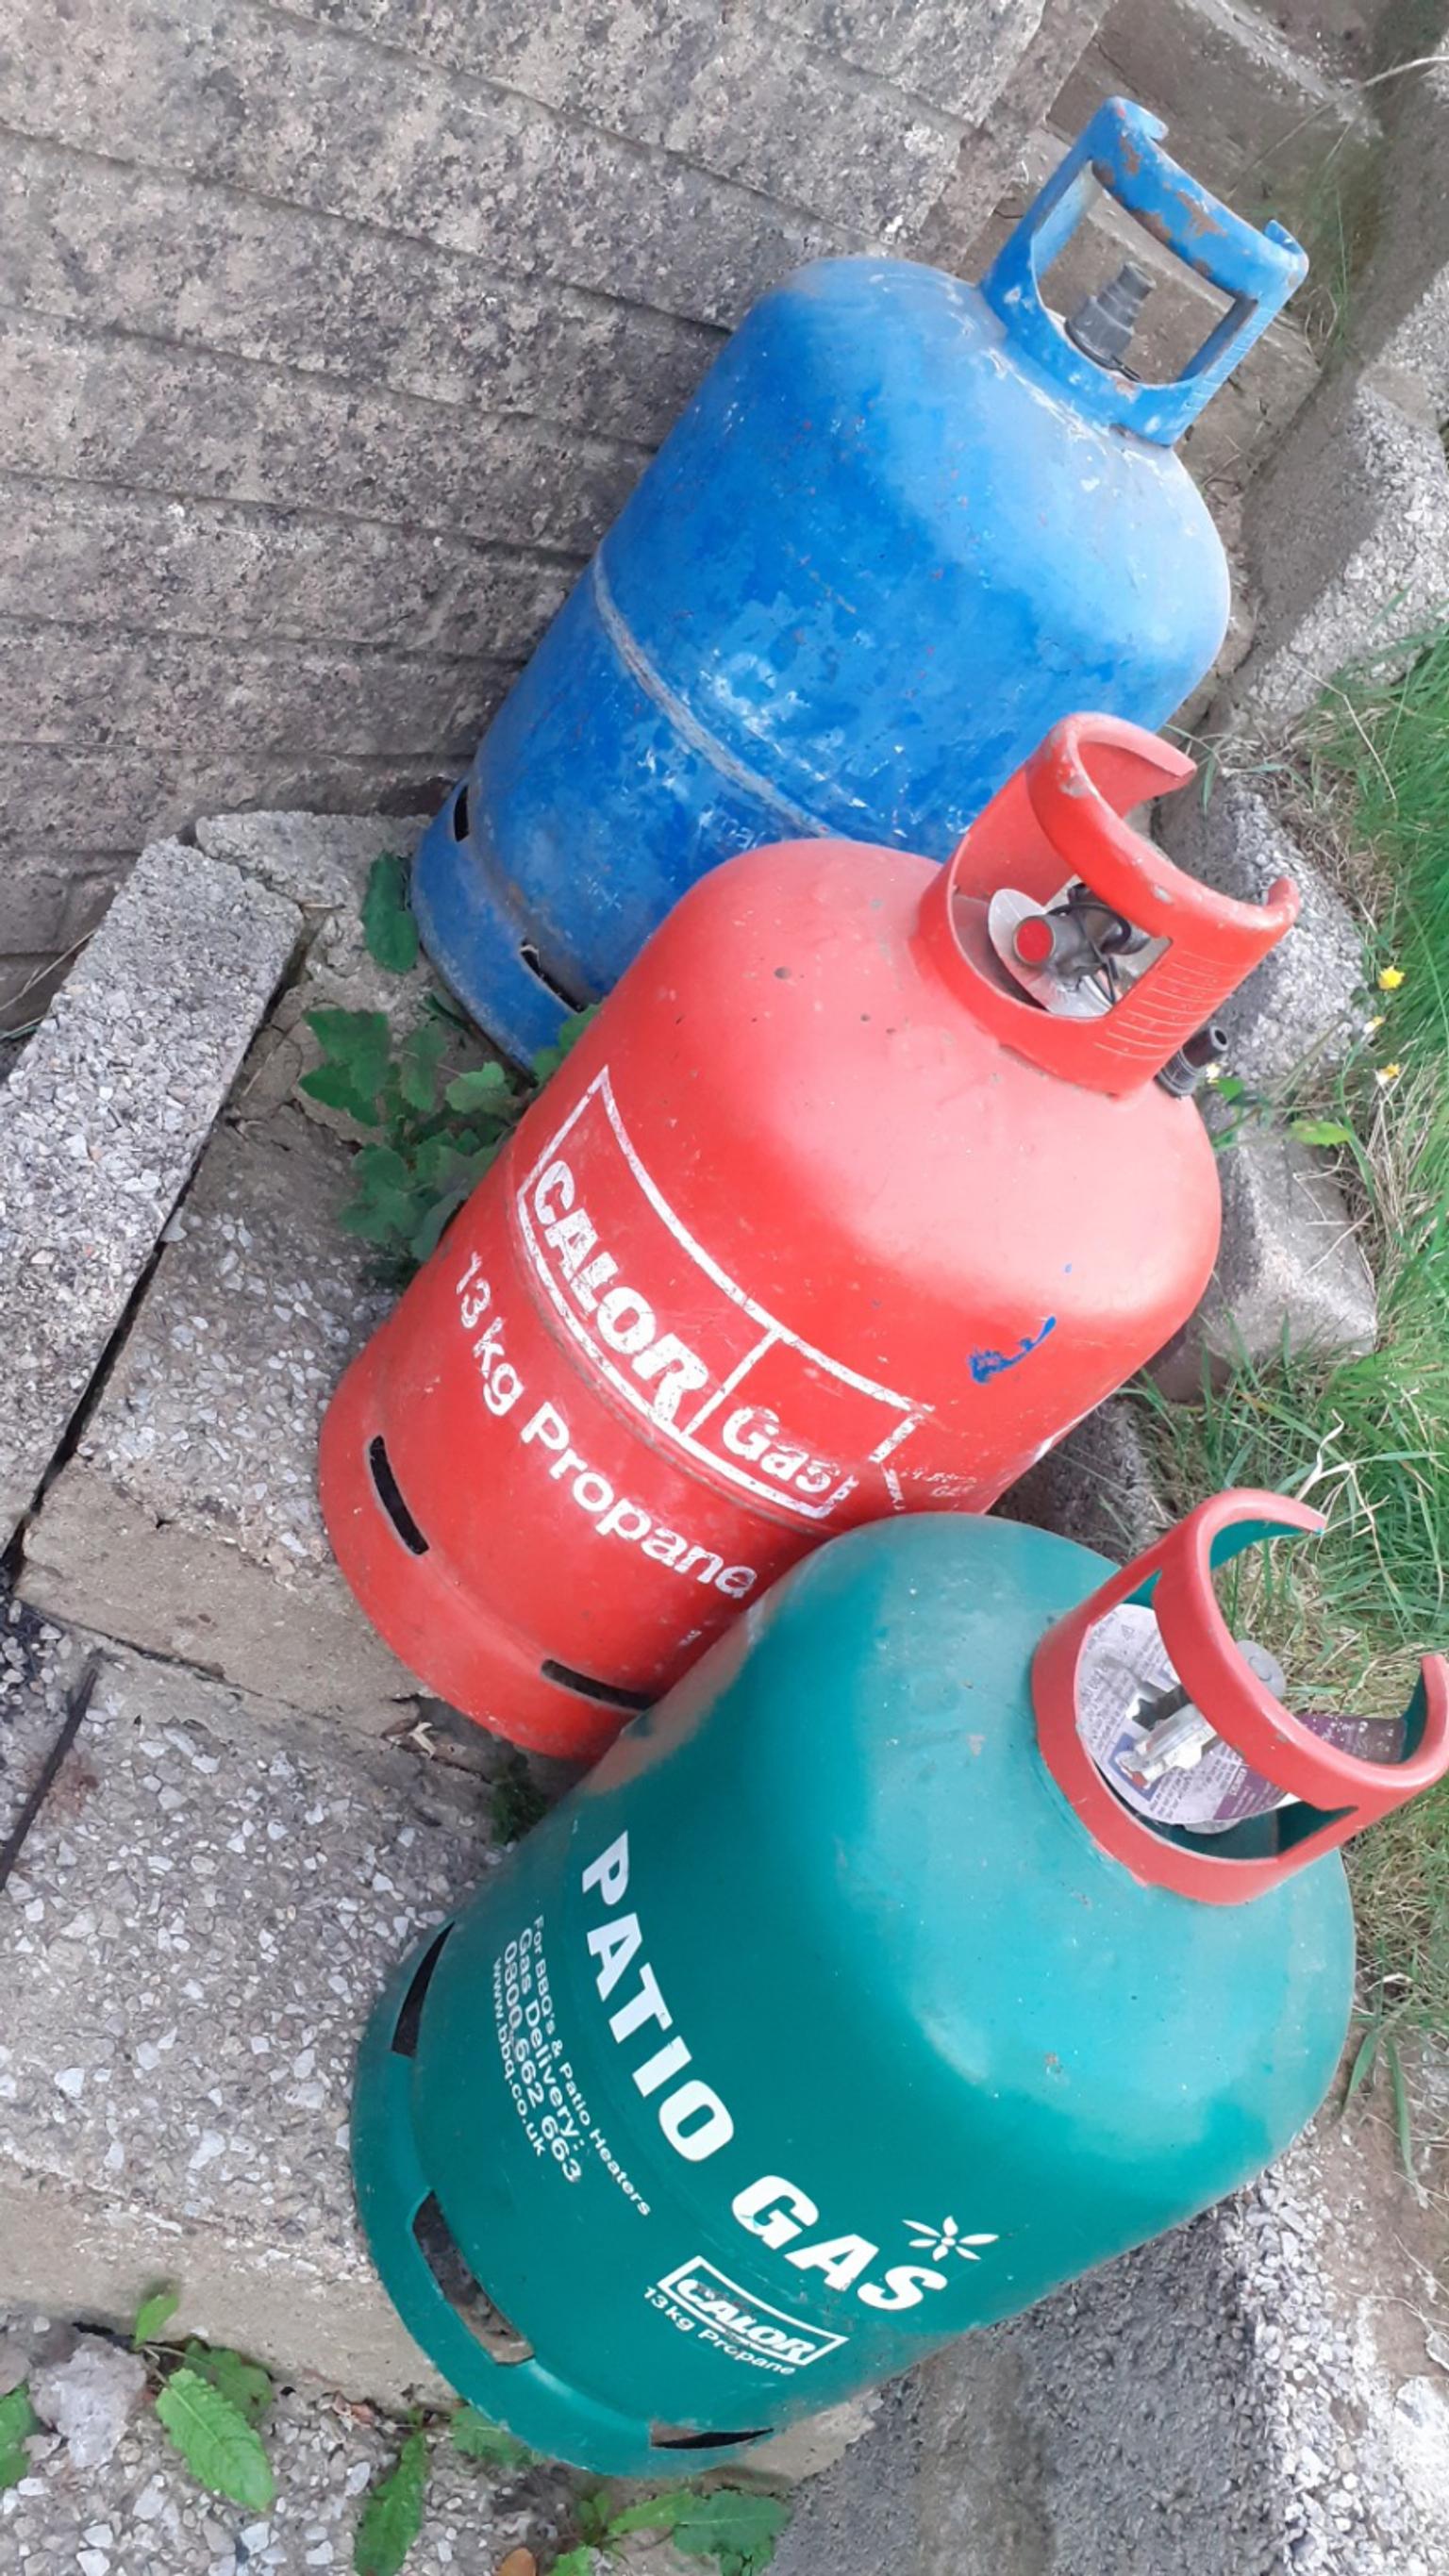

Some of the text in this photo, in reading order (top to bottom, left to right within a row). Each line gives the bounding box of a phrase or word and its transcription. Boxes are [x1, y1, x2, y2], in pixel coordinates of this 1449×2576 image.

[534, 1160, 841, 1494] CALOR Gas
[521, 1402, 758, 1599] Propane
[492, 1957, 546, 2157] www.bbq.co.uk
[503, 1941, 582, 2184] 0800 662 663
[518, 1927, 585, 2151] Gas Delivery:
[532, 1915, 650, 2216] For BBQ's & Patio Heaters
[582, 1831, 948, 2311] PATIO GAS
[677, 2278, 819, 2364] CALOR
[696, 2327, 796, 2376] Propane
